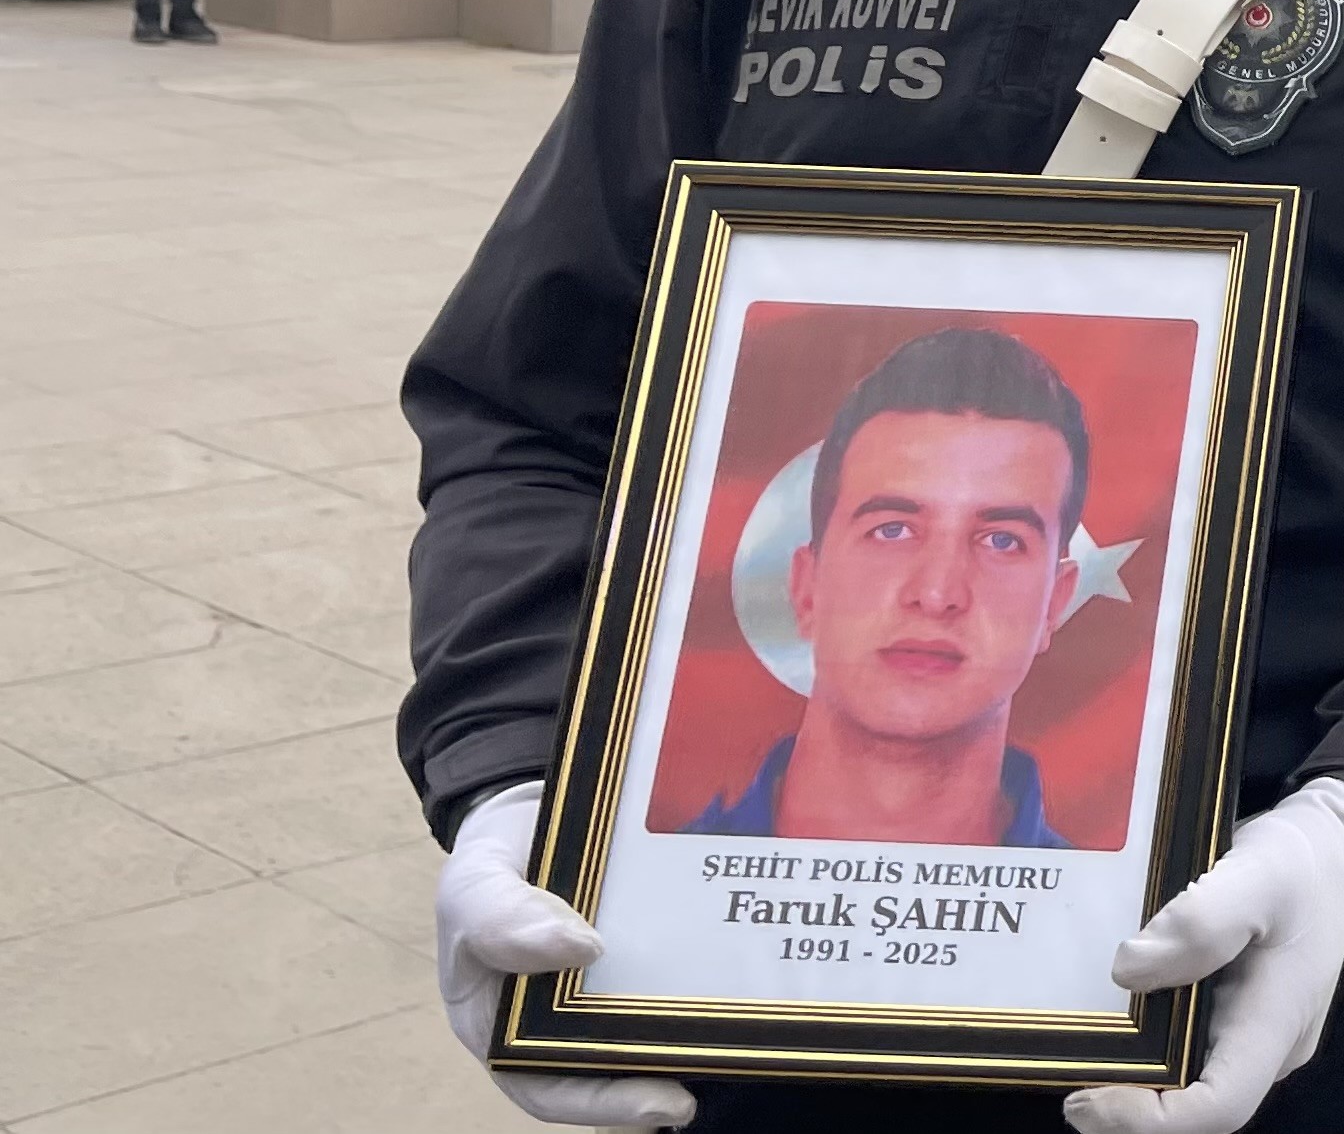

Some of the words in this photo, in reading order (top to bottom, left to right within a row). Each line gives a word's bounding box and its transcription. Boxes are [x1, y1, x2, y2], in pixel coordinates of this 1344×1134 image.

[702, 851, 802, 882] ŞEHİT
[810, 856, 904, 884] POLİS
[913, 862, 1062, 890] MEMURU
[722, 890, 857, 927] Faruk
[870, 891, 1026, 936] ŞAHİN
[779, 937, 851, 962] 1991
[883, 941, 958, 966] 2025
